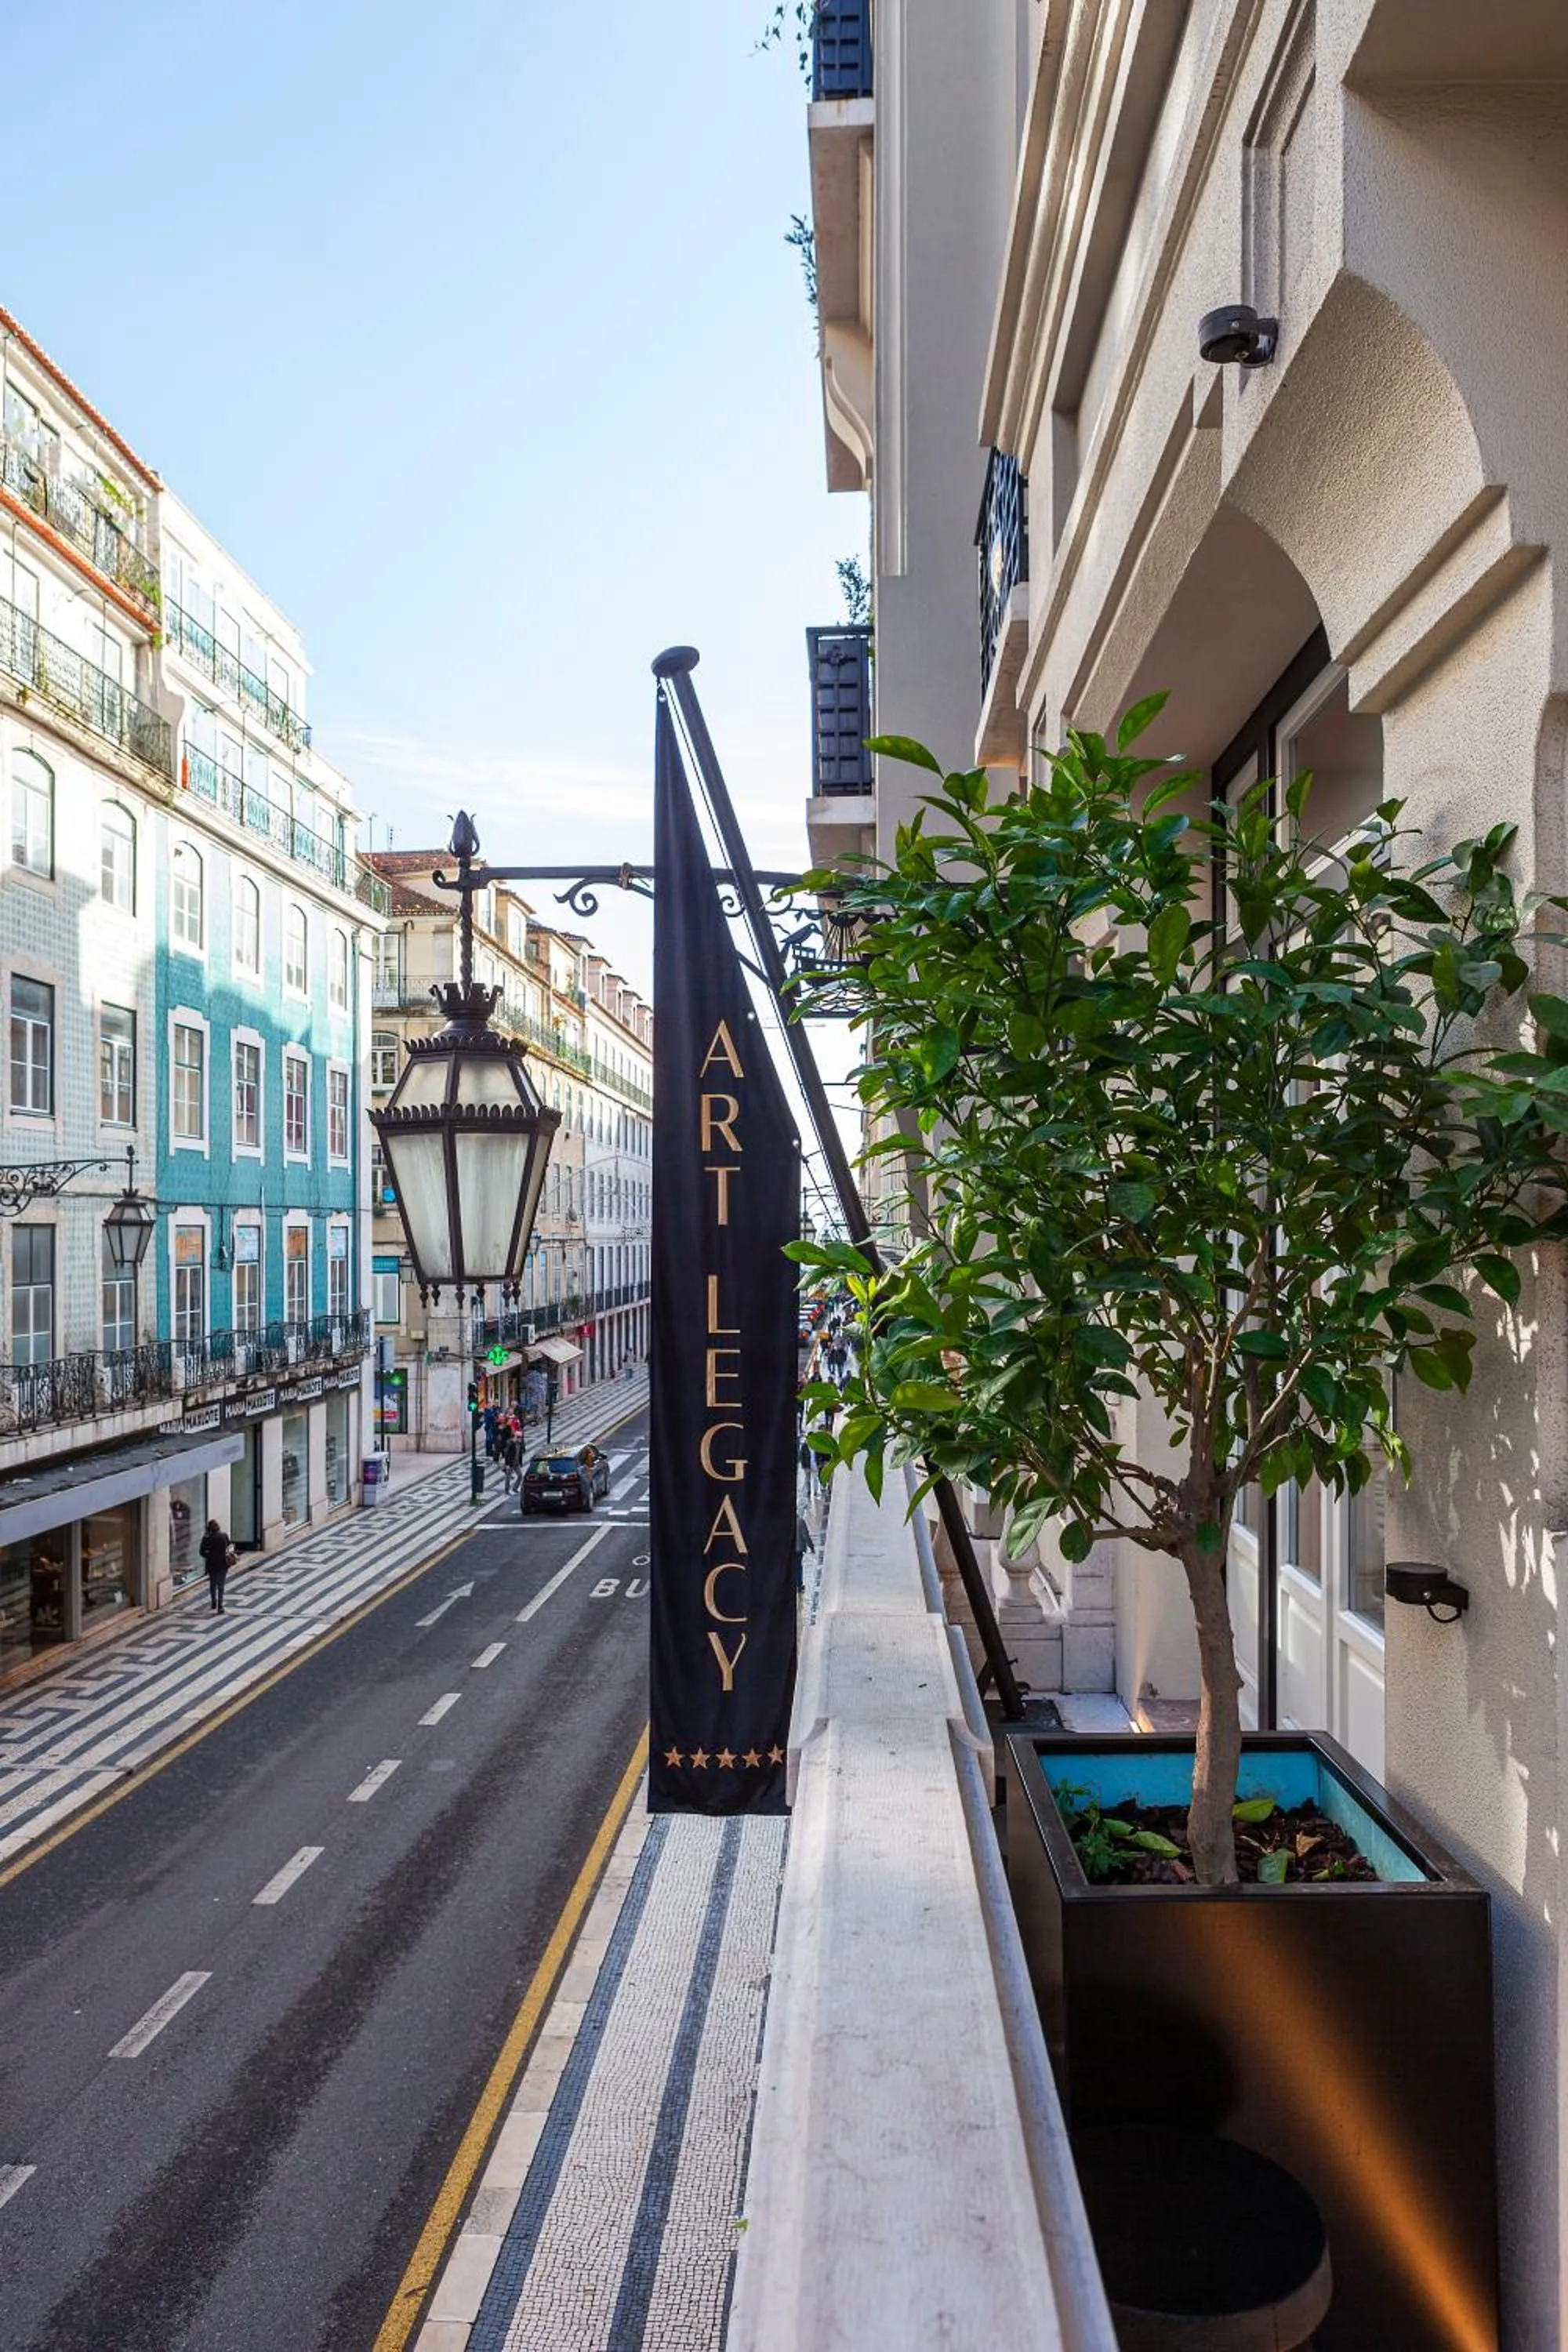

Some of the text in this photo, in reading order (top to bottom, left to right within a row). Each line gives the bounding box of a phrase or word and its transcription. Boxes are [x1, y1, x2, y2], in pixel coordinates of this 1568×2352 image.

[700, 1019, 748, 1691] ART LEGACY
[590, 1578, 651, 1598] BU
